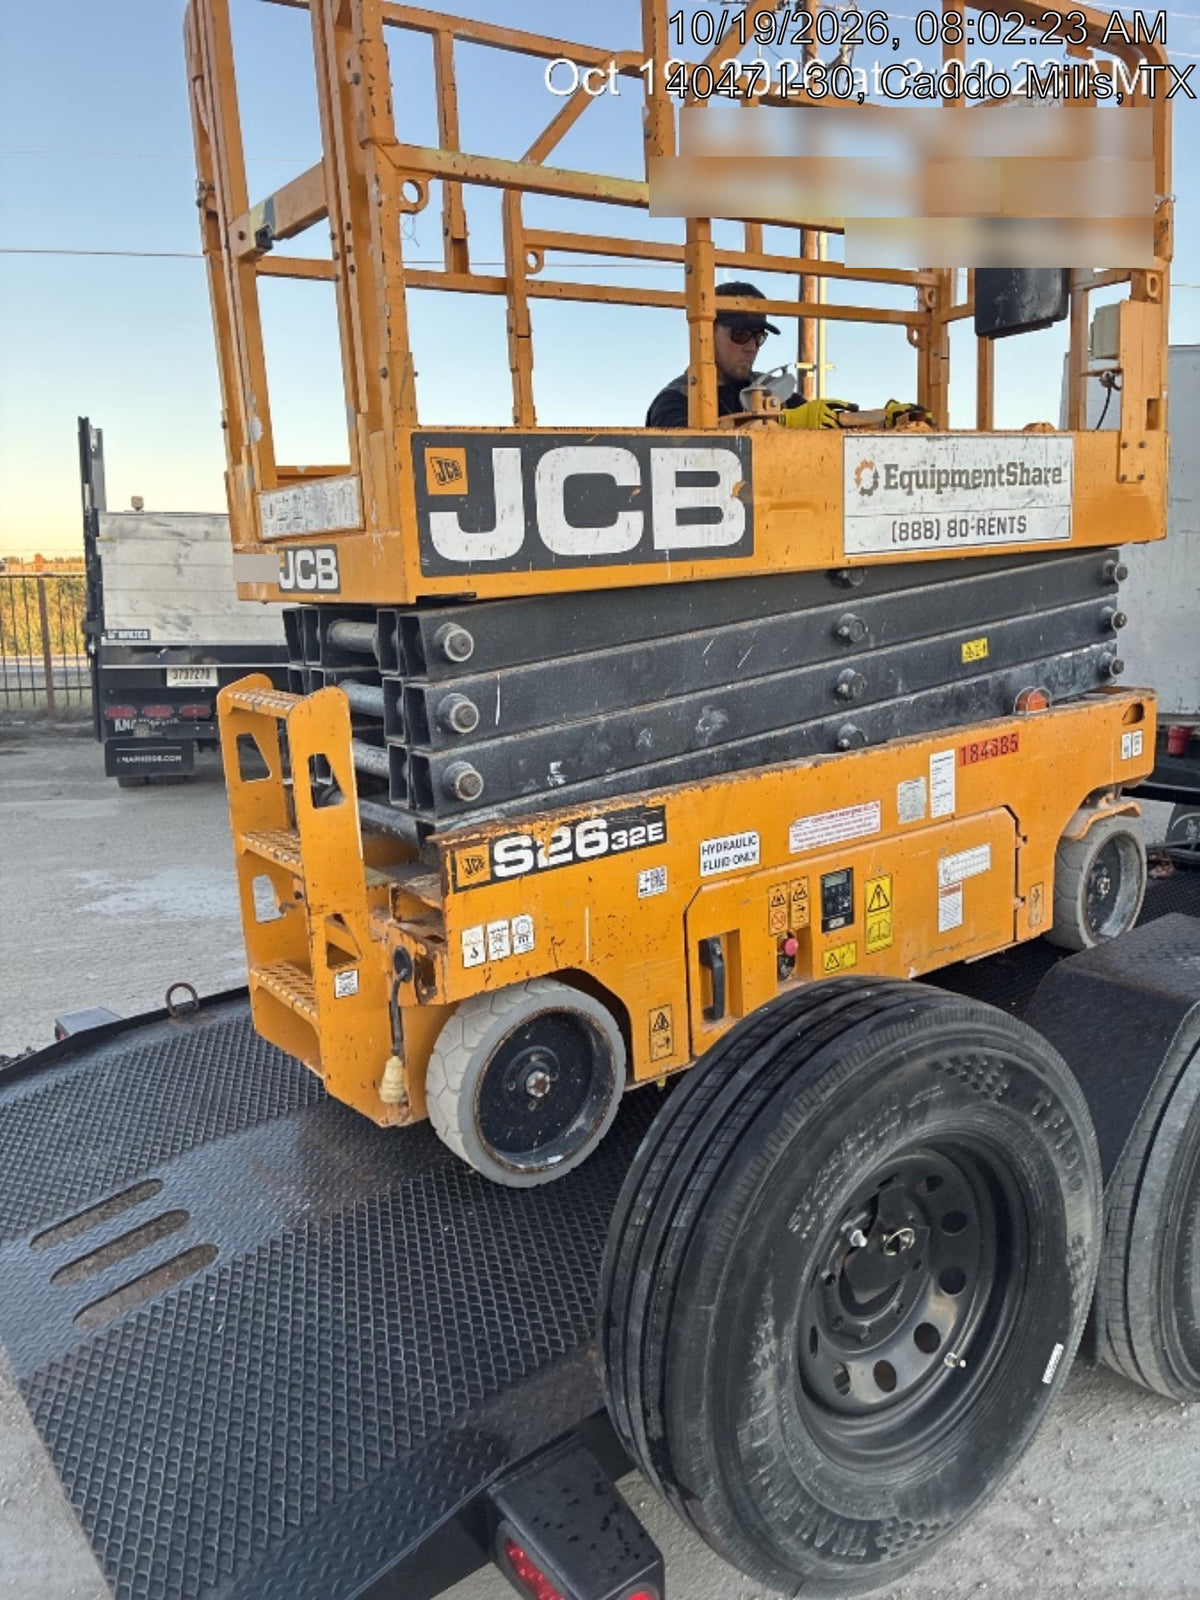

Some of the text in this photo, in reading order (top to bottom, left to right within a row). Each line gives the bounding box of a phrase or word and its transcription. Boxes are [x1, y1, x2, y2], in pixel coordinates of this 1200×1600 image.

[883, 462, 1063, 496] EquipmentShare
[429, 446, 747, 562] JCB
[891, 515, 1027, 543] (888) 80-RENTS
[280, 549, 338, 589] JCB
[493, 819, 664, 877] S26 32E
[702, 835, 757, 855] HYDRAULIC
[703, 851, 757, 871] FLUID ONLY
